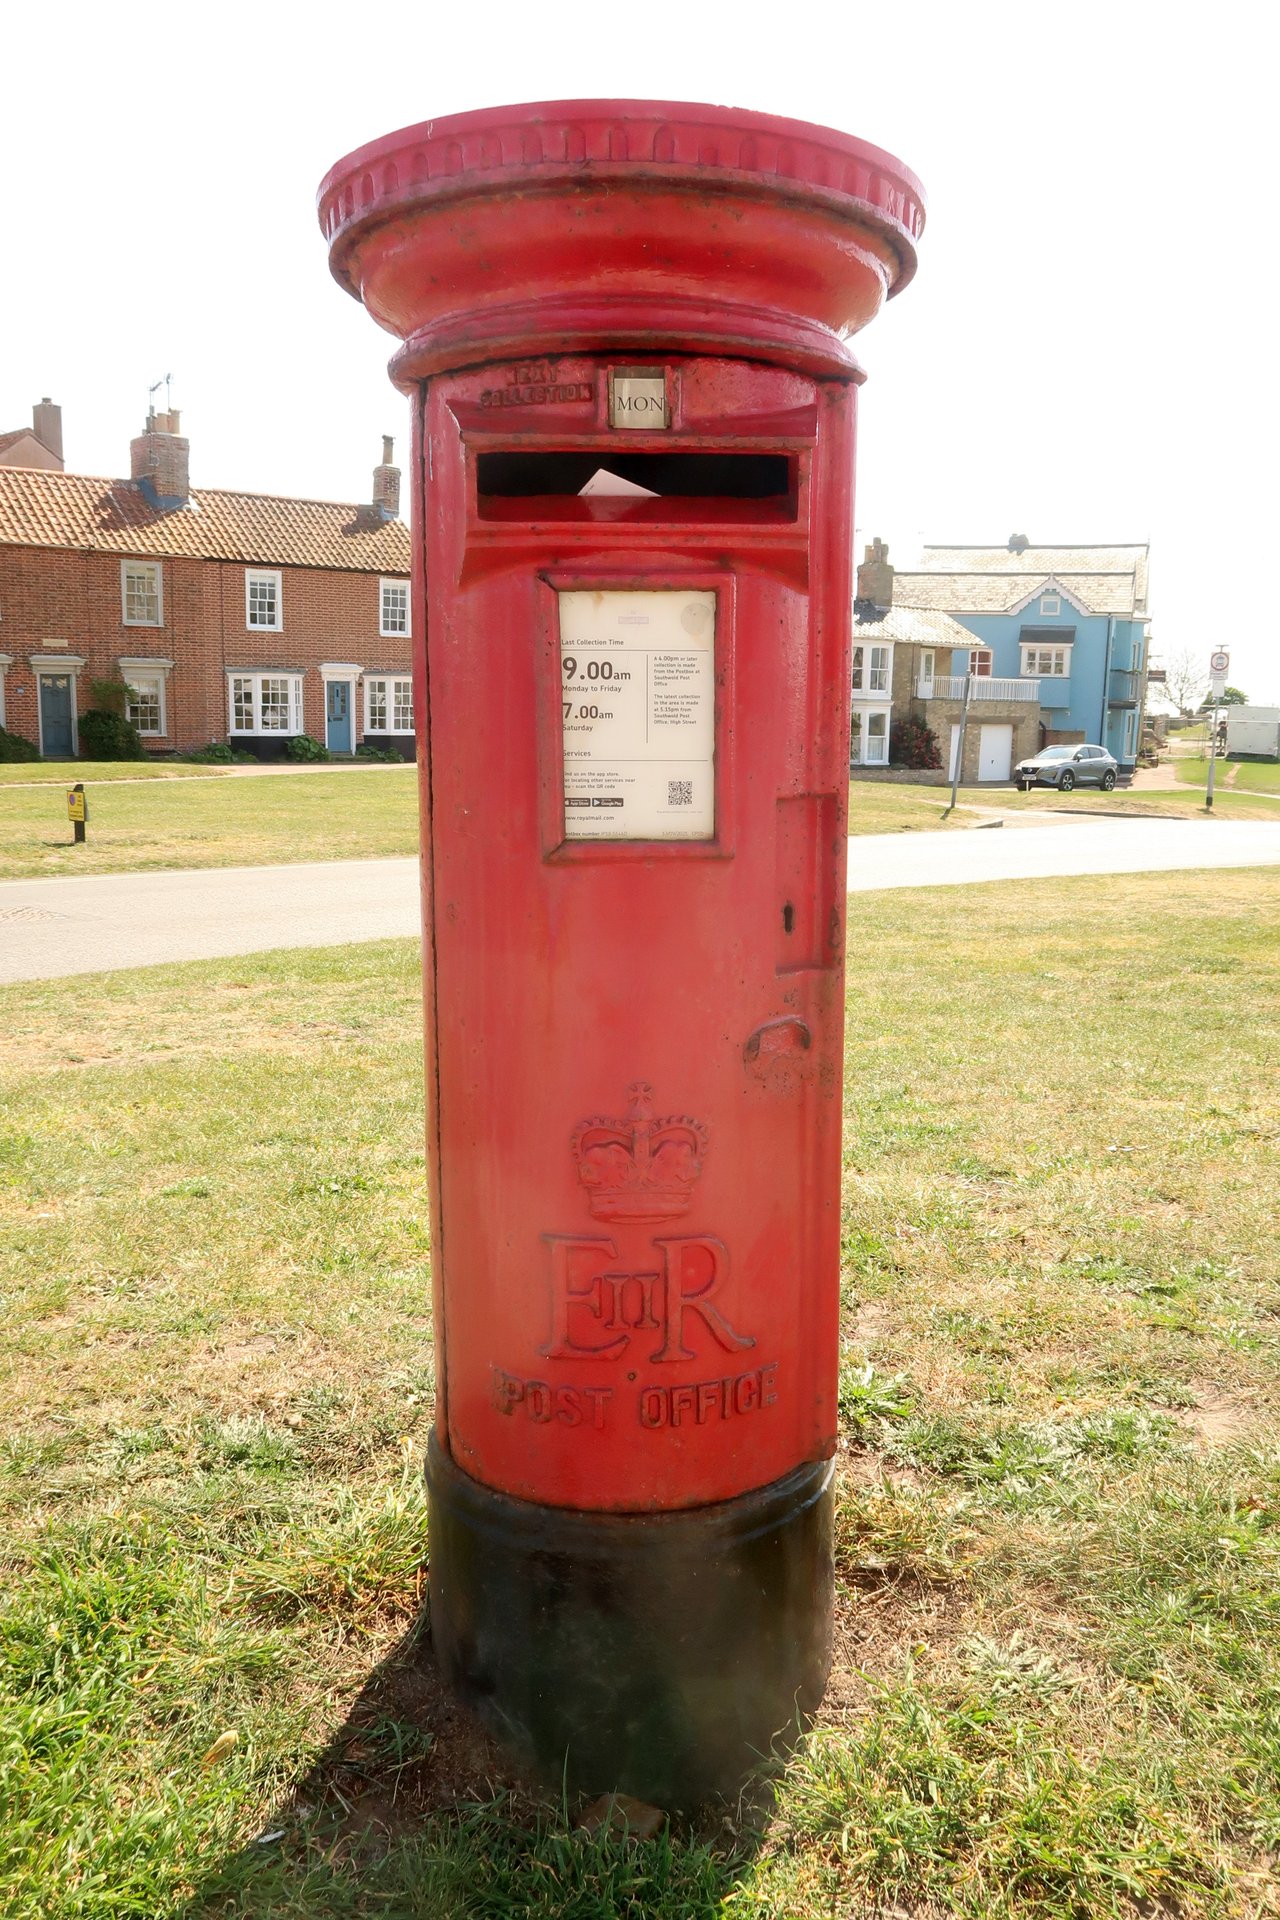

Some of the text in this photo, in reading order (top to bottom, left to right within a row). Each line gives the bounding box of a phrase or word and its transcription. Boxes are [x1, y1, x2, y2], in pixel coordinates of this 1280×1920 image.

[617, 396, 664, 411] MON
[562, 656, 631, 680] 9.00am
[562, 685, 622, 693] Monday to Friday
[562, 703, 614, 719] 7.00am
[562, 724, 593, 732] Saturday
[493, 1361, 779, 1430] POST OFFICE
